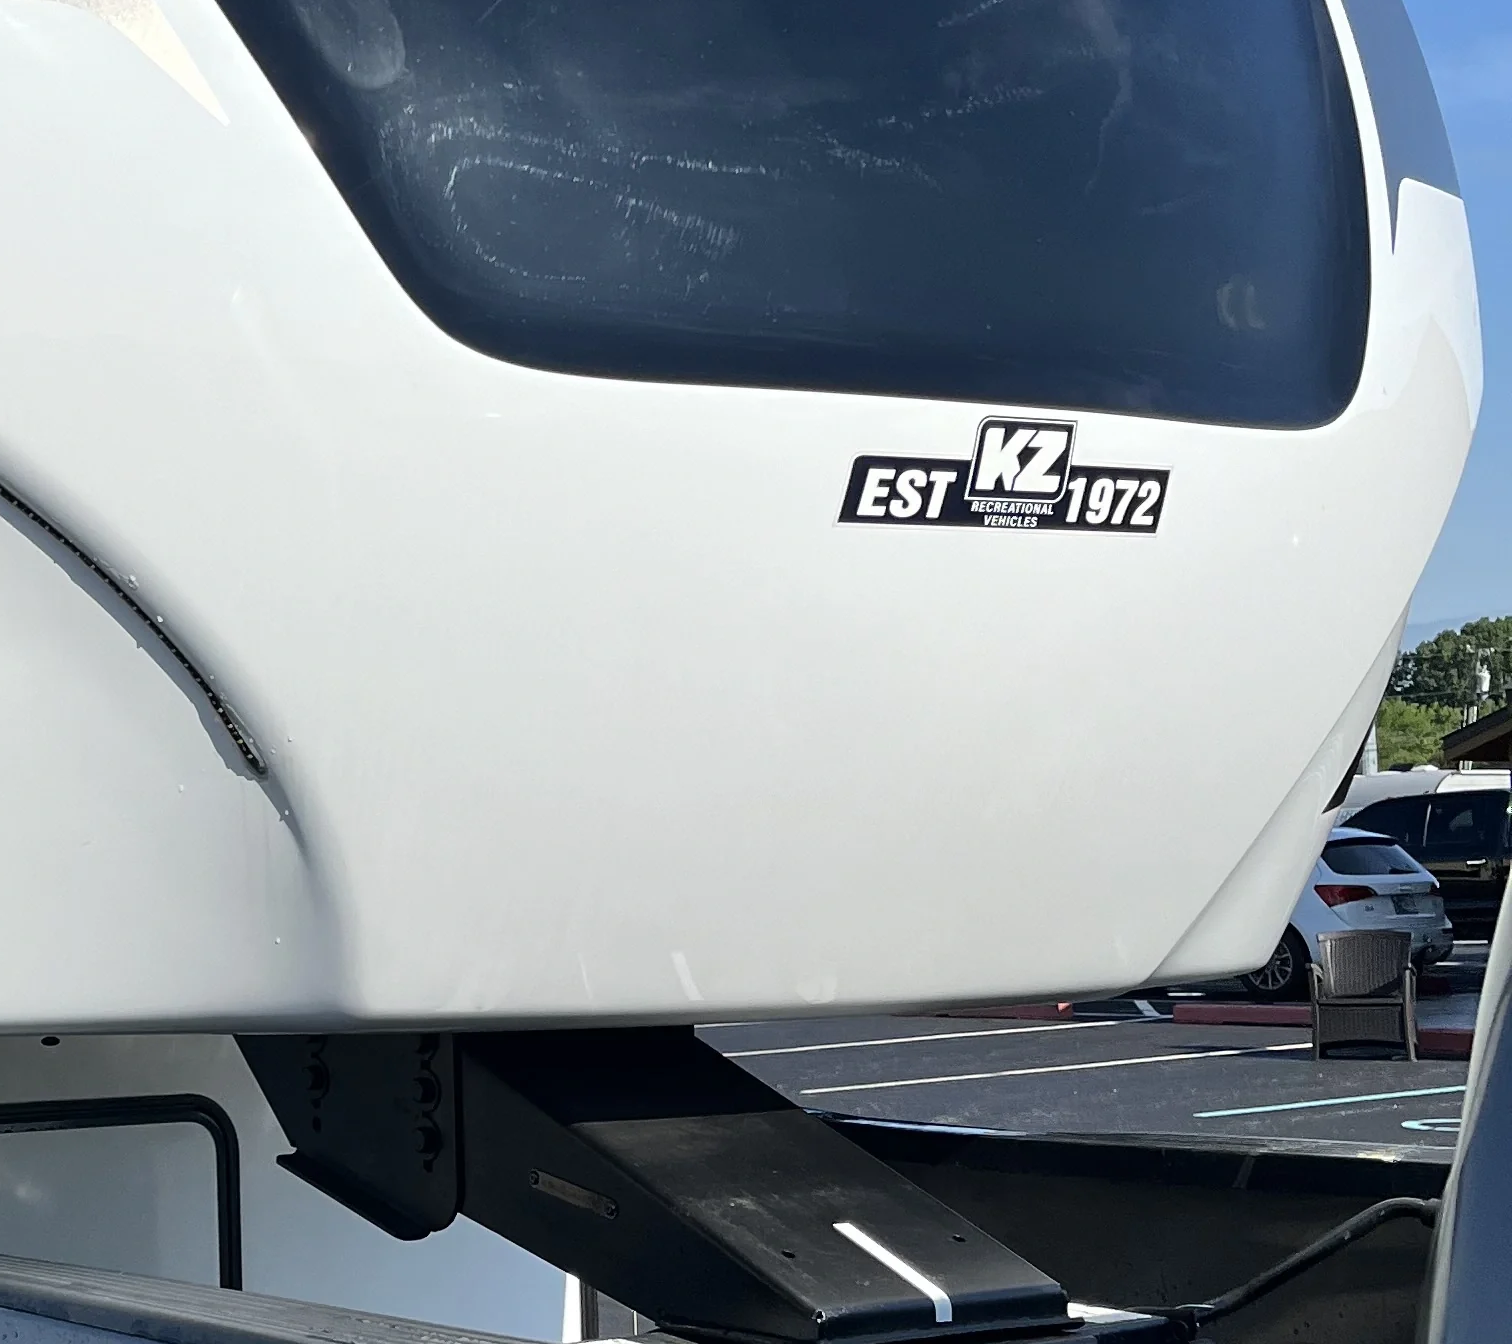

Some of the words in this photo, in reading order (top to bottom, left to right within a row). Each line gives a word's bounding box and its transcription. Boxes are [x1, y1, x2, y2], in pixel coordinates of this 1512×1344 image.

[975, 426, 1070, 493] KZ
[856, 467, 958, 519] EST
[1065, 477, 1162, 527] 1972
[970, 500, 1055, 516] RECREATIONAL
[983, 513, 1039, 529] VEHICLES
